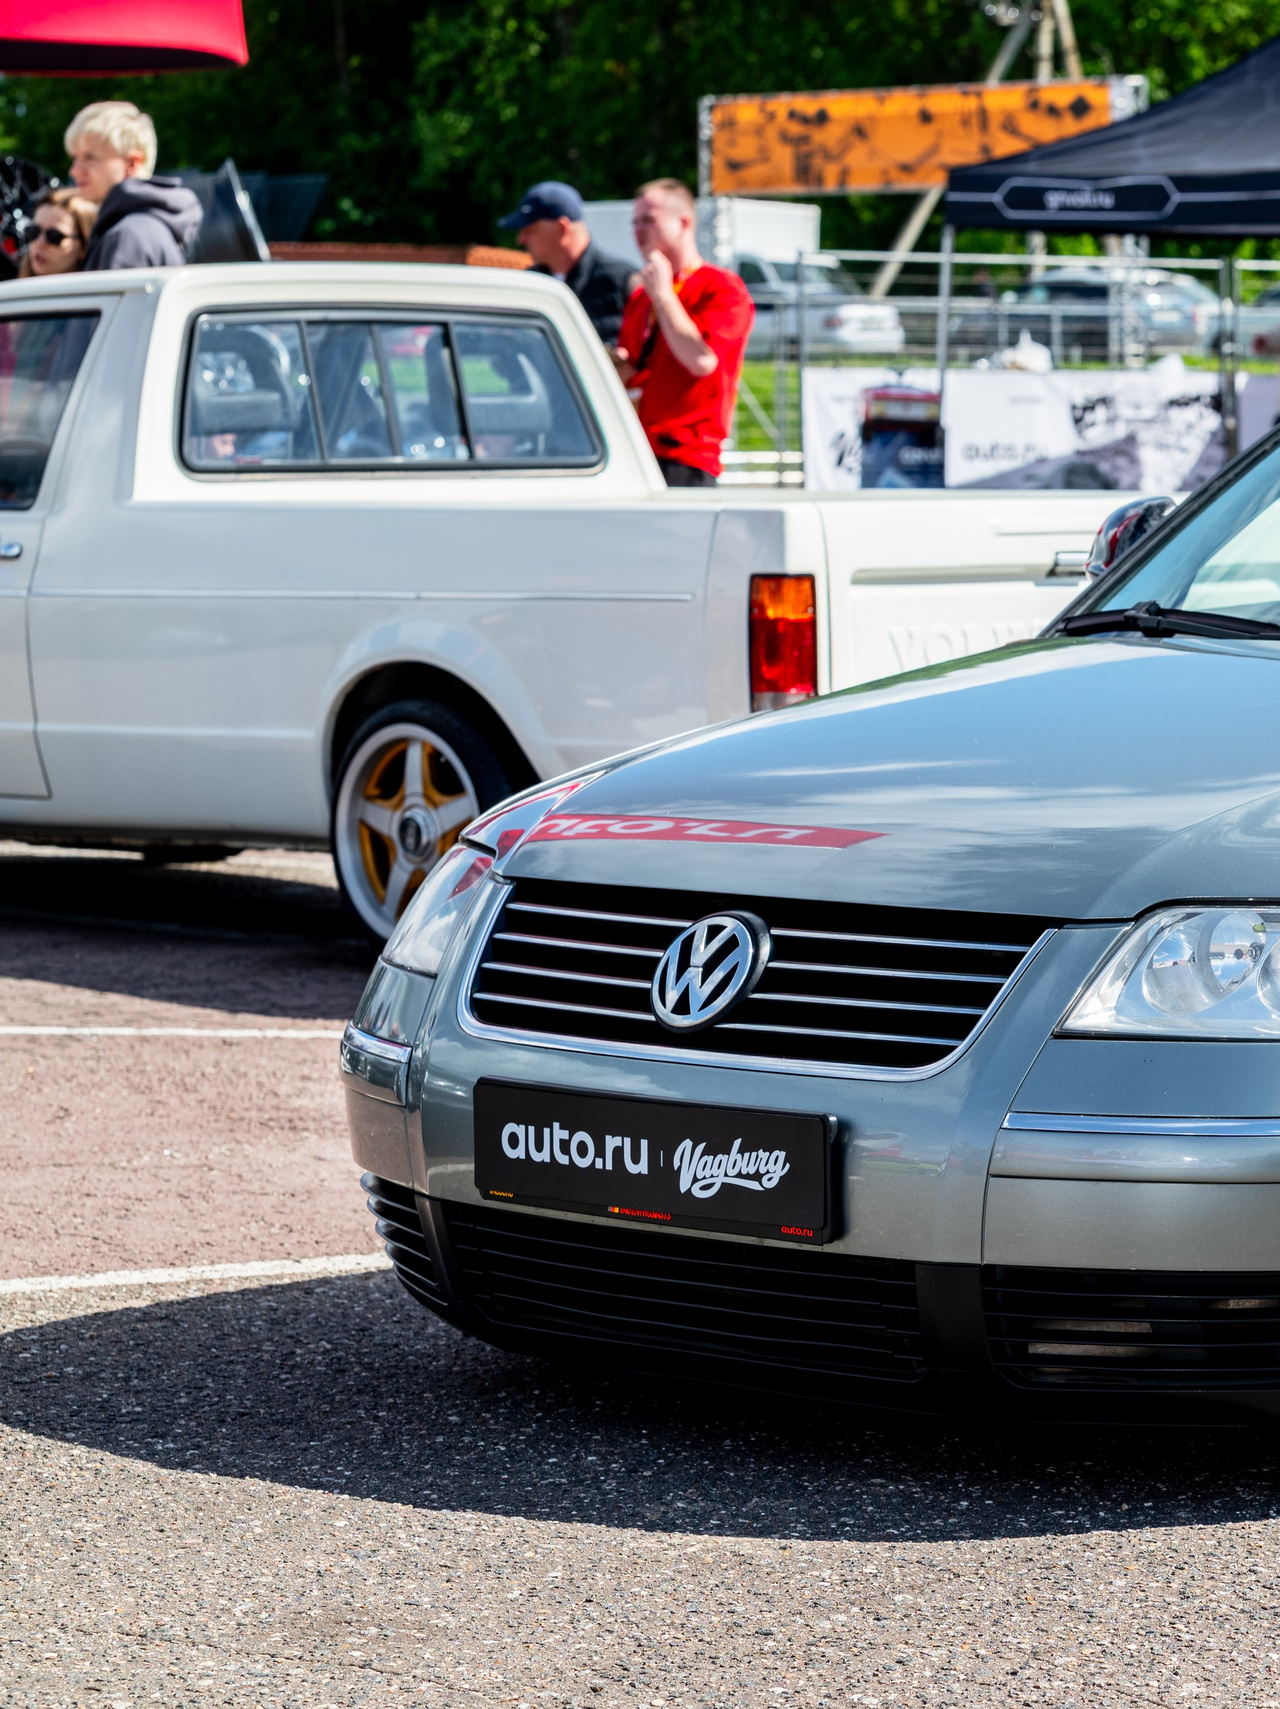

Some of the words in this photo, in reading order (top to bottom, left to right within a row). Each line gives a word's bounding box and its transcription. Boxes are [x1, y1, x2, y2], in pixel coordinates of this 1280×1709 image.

[501, 1122, 649, 1175] auto.ru
[673, 1138, 791, 1199] Vagburg
[781, 1226, 813, 1237] auto.ru
